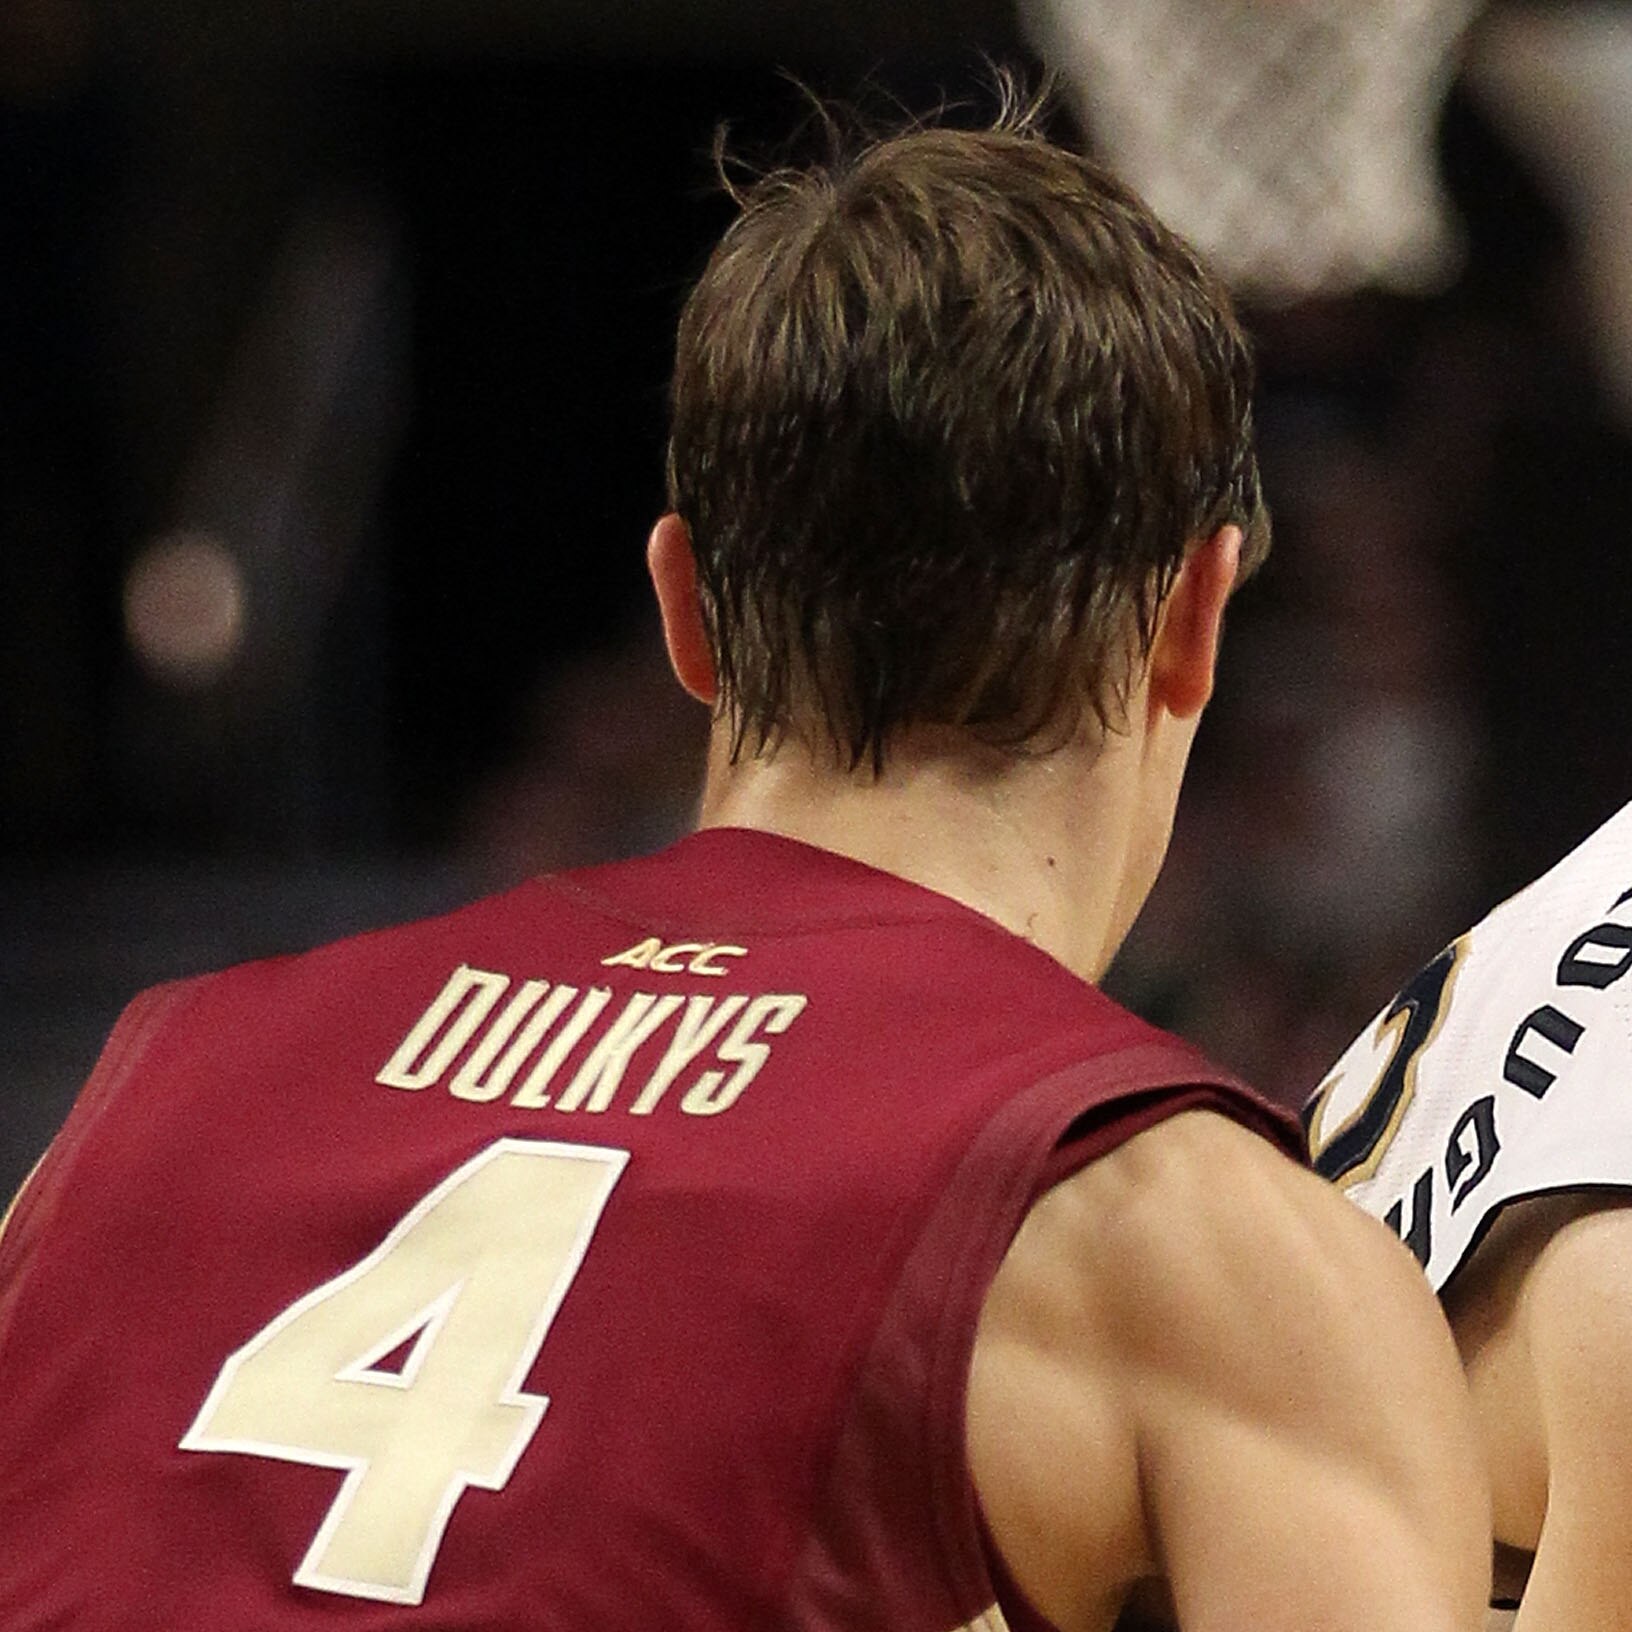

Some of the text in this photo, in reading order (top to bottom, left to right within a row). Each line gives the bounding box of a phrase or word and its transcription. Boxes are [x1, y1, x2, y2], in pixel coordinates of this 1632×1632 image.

[601, 938, 747, 976] ACC
[375, 964, 807, 1115] DULKYS
[178, 1136, 631, 1606] 4
